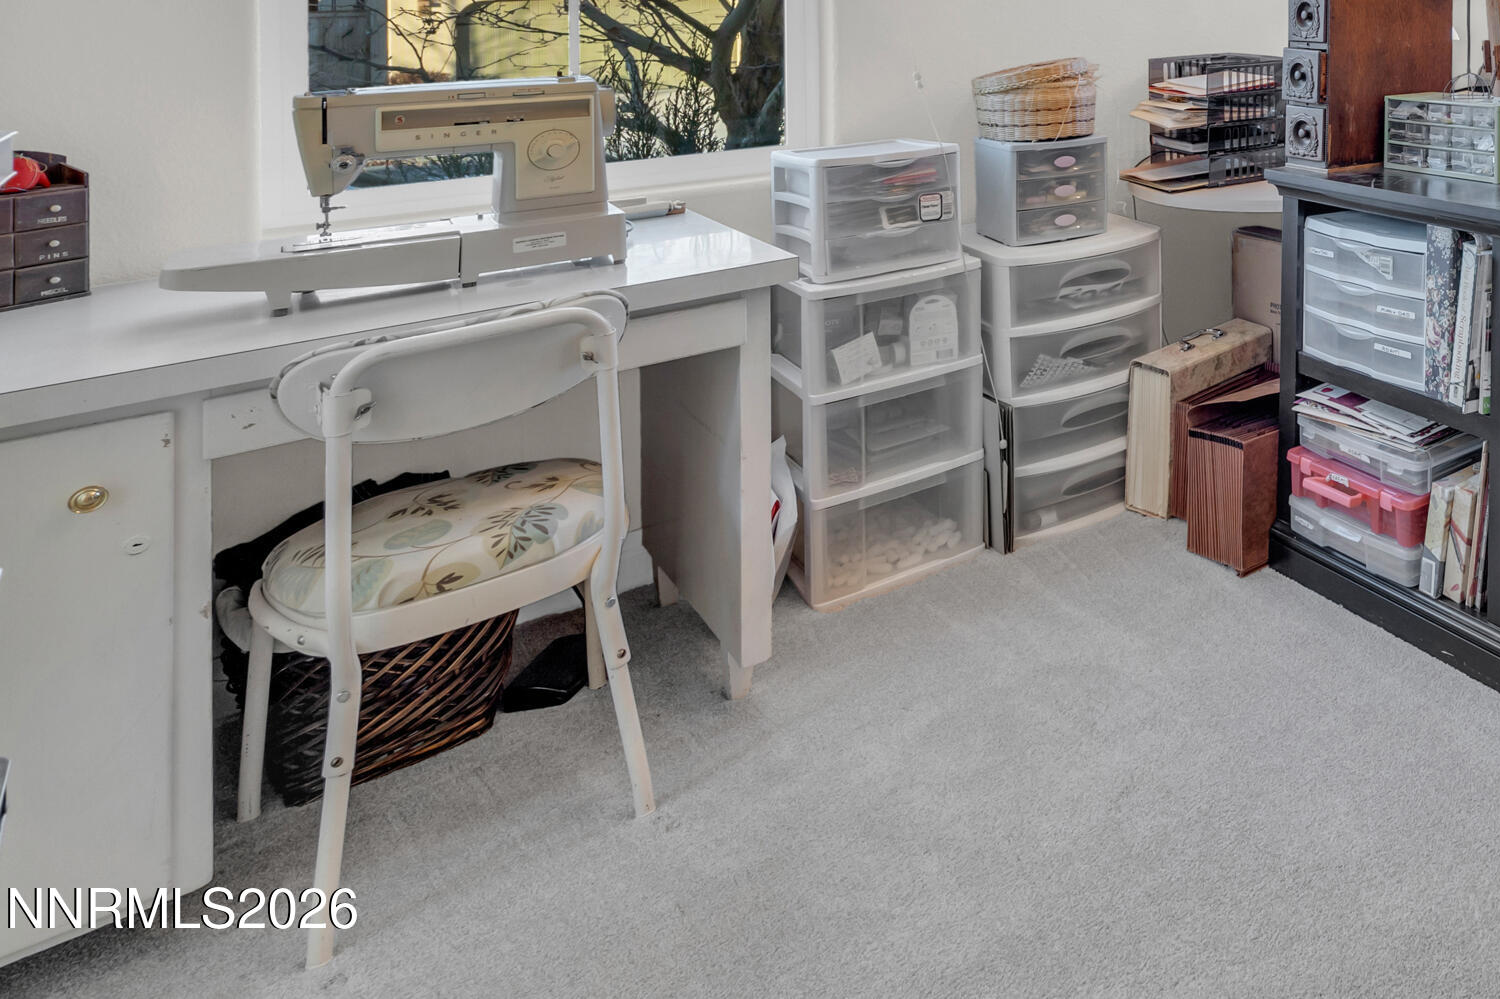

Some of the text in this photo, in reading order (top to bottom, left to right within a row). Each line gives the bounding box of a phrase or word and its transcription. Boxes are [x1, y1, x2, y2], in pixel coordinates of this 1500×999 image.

[415, 128, 498, 141] SINGER
[39, 251, 69, 260] PINS
[1455, 316, 1467, 380] Scrapbooking
